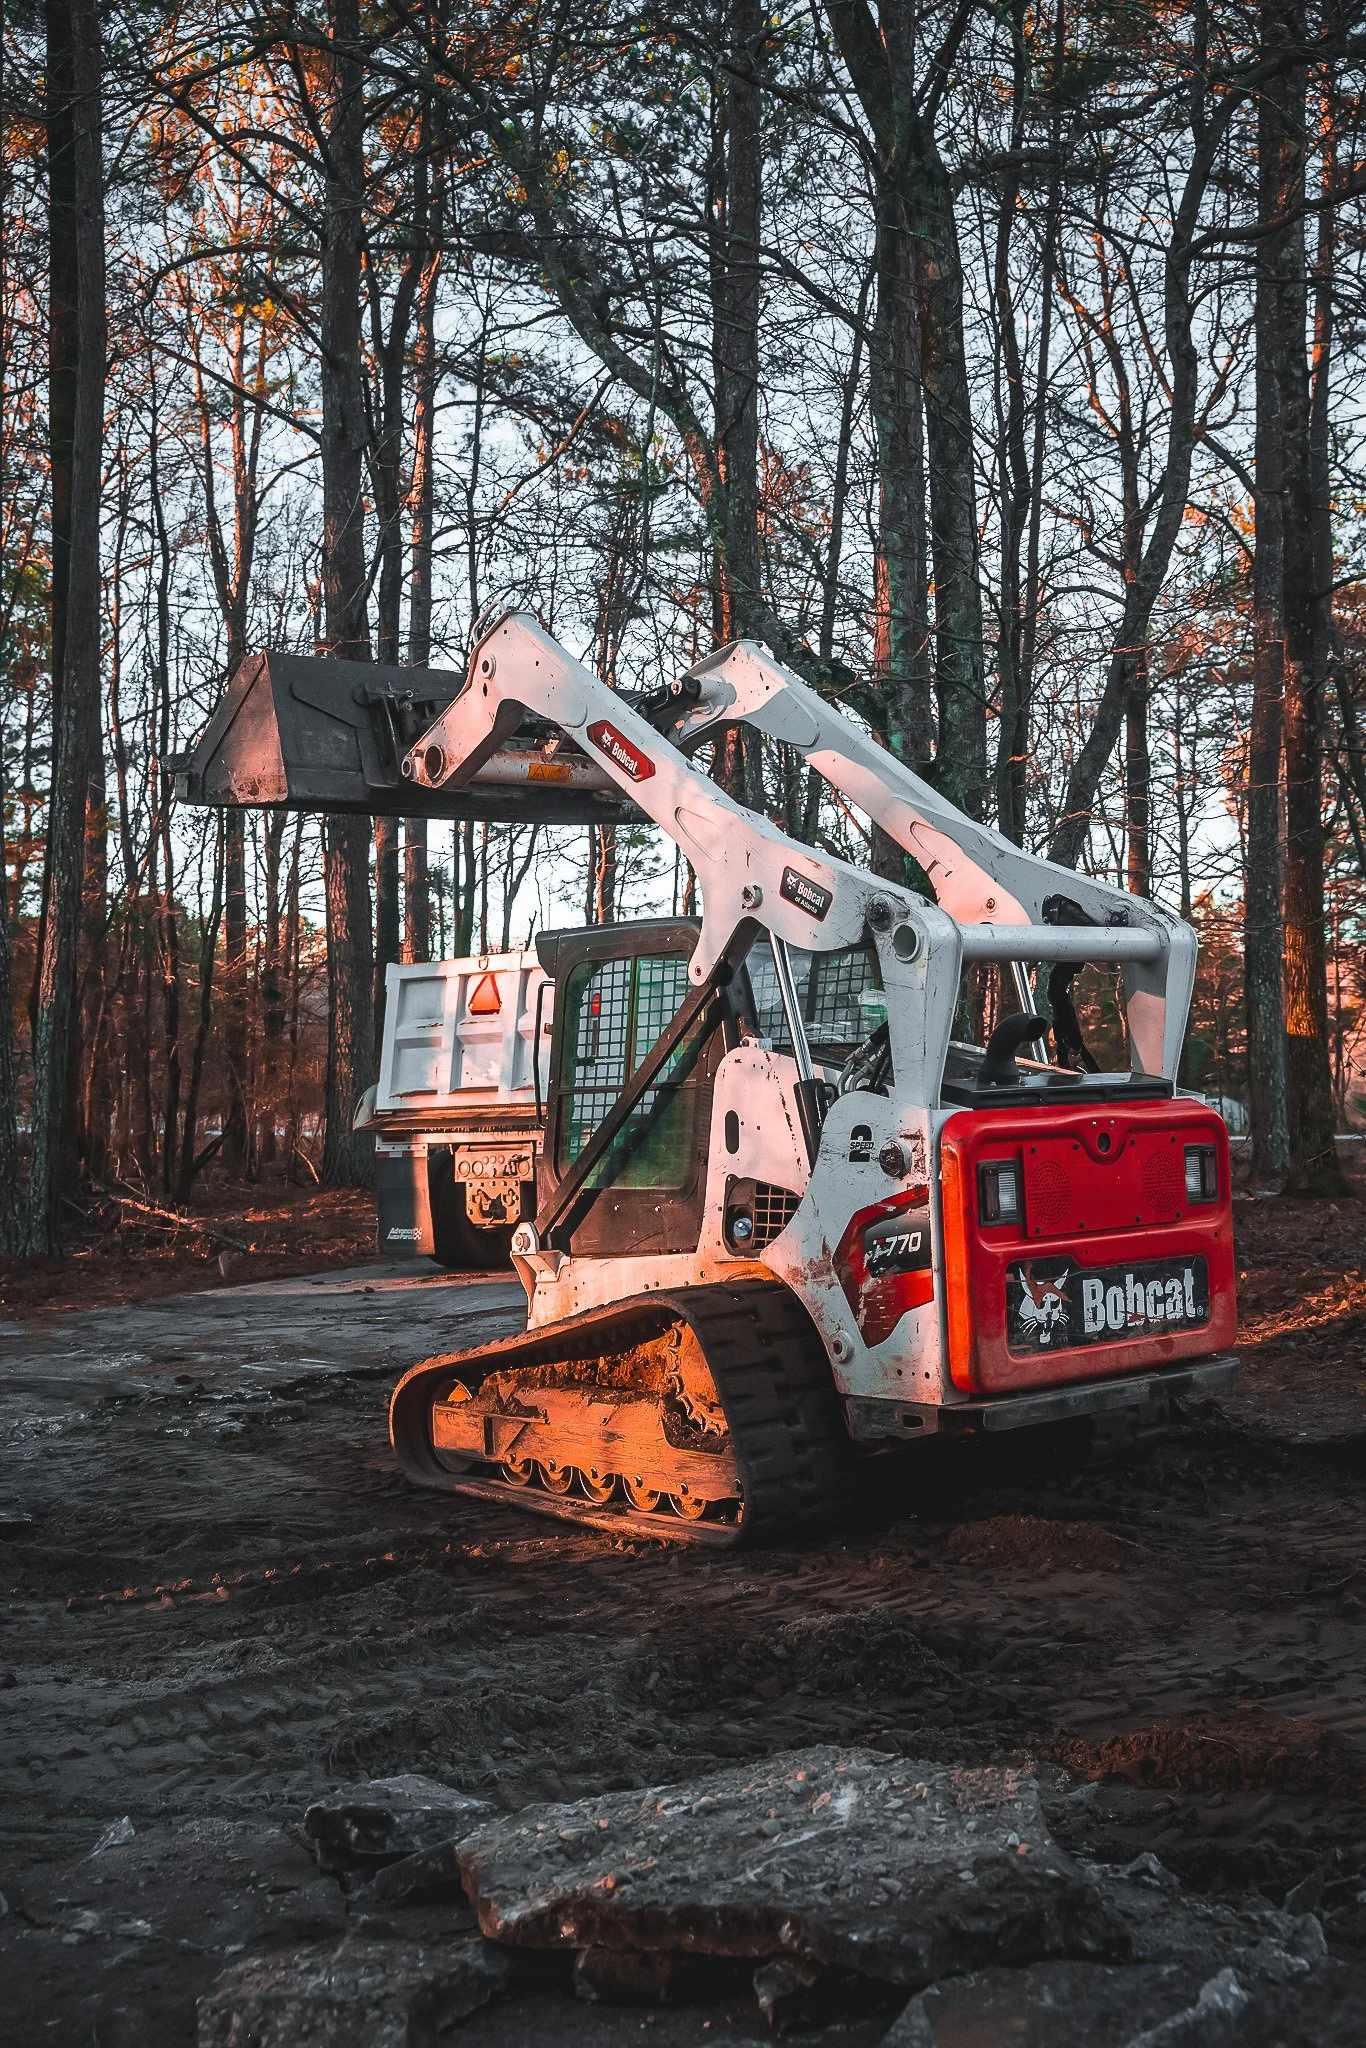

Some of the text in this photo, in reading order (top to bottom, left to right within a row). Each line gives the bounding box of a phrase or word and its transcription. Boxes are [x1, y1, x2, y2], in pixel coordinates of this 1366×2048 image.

[611, 741, 639, 774] Bobcat
[797, 881, 825, 908] Bobcat
[849, 1124, 873, 1163] 2
[850, 1141, 875, 1150] SPEED
[1082, 1268, 1196, 1334] Bobcat
